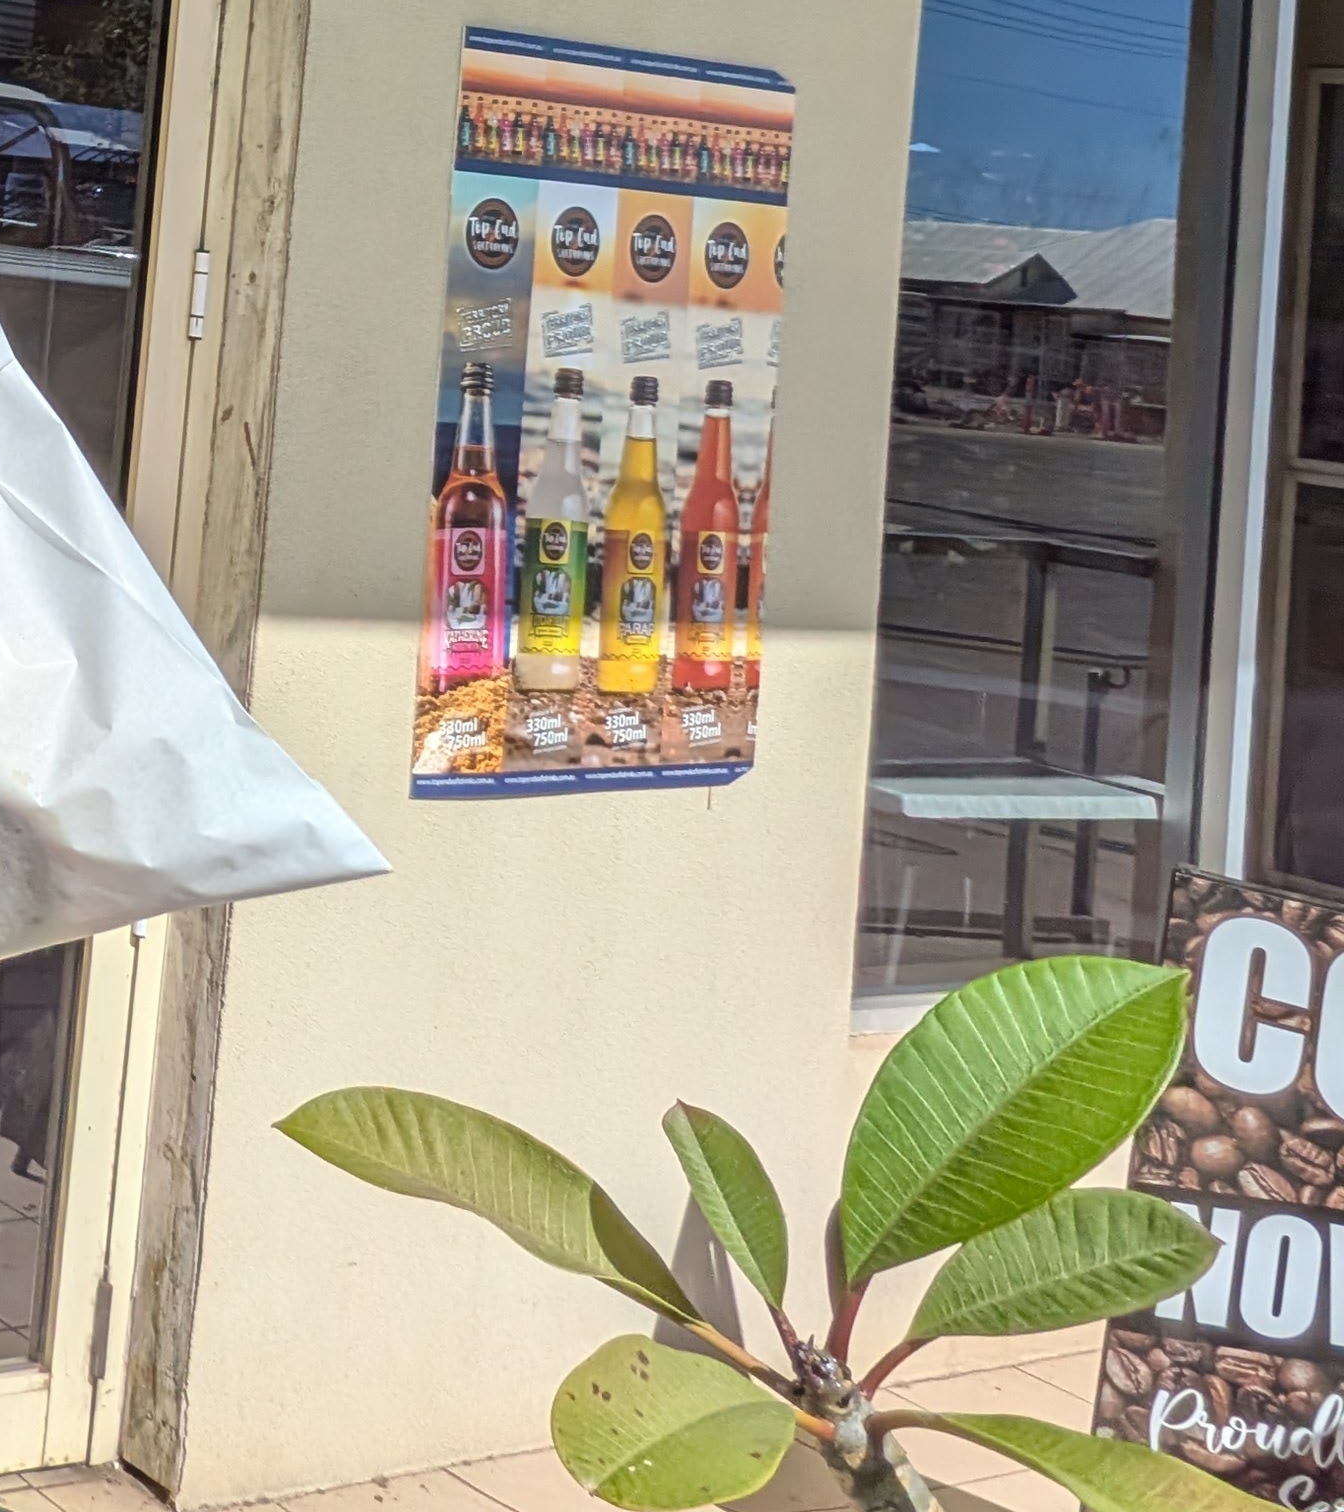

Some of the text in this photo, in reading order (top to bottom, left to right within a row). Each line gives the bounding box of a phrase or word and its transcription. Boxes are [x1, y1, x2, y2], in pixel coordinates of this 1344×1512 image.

[439, 717, 478, 736] 330ml
[526, 714, 562, 733] 330ml
[604, 711, 640, 730] 330ml
[681, 709, 715, 727] 330ml
[449, 731, 487, 749] 750ml
[534, 728, 569, 746] 750ml
[613, 725, 647, 744] 750ml
[689, 722, 722, 740] 750ml
[1194, 916, 1344, 1124] C
[1154, 1200, 1344, 1346] NO
